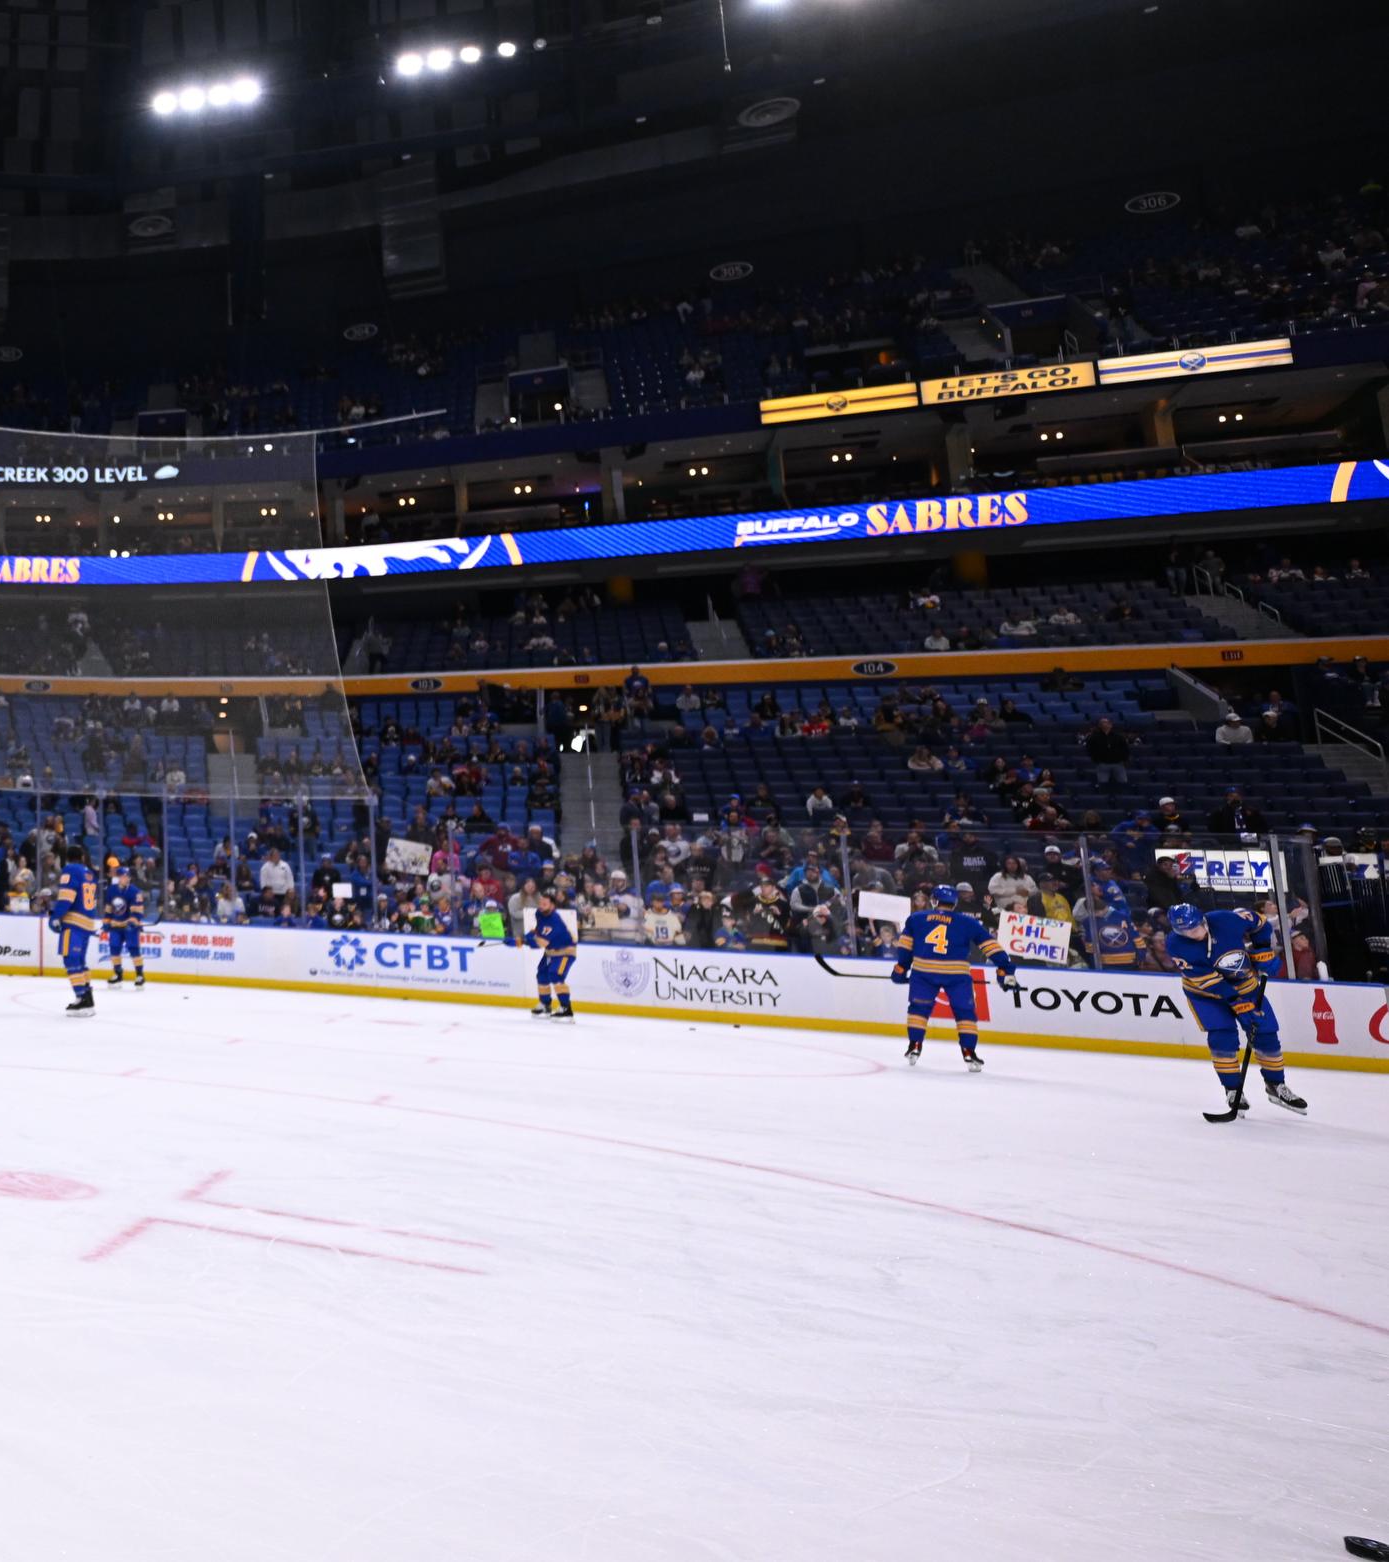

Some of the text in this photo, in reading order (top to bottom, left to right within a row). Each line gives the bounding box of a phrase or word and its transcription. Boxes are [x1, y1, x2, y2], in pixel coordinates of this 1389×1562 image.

[1138, 195, 1167, 210] 306
[937, 376, 1079, 400] BUFFALO!
[941, 367, 1071, 389] LET'S GO
[52, 467, 89, 483] 300
[95, 466, 148, 483] LEVEL
[736, 493, 1029, 536] BUFFALO SABRES
[863, 663, 884, 673] 104
[1187, 856, 1269, 878] FREY
[1007, 914, 1024, 924] MY
[654, 926, 669, 940] 19
[925, 924, 949, 954] 4
[1011, 925, 1051, 940] NHL
[374, 941, 474, 972] CFBT
[1010, 939, 1065, 961] GAME!
[653, 957, 779, 987] NIAGARA
[655, 981, 781, 1007] UNIVERSITY
[1012, 986, 1184, 1019] TOYOTA
